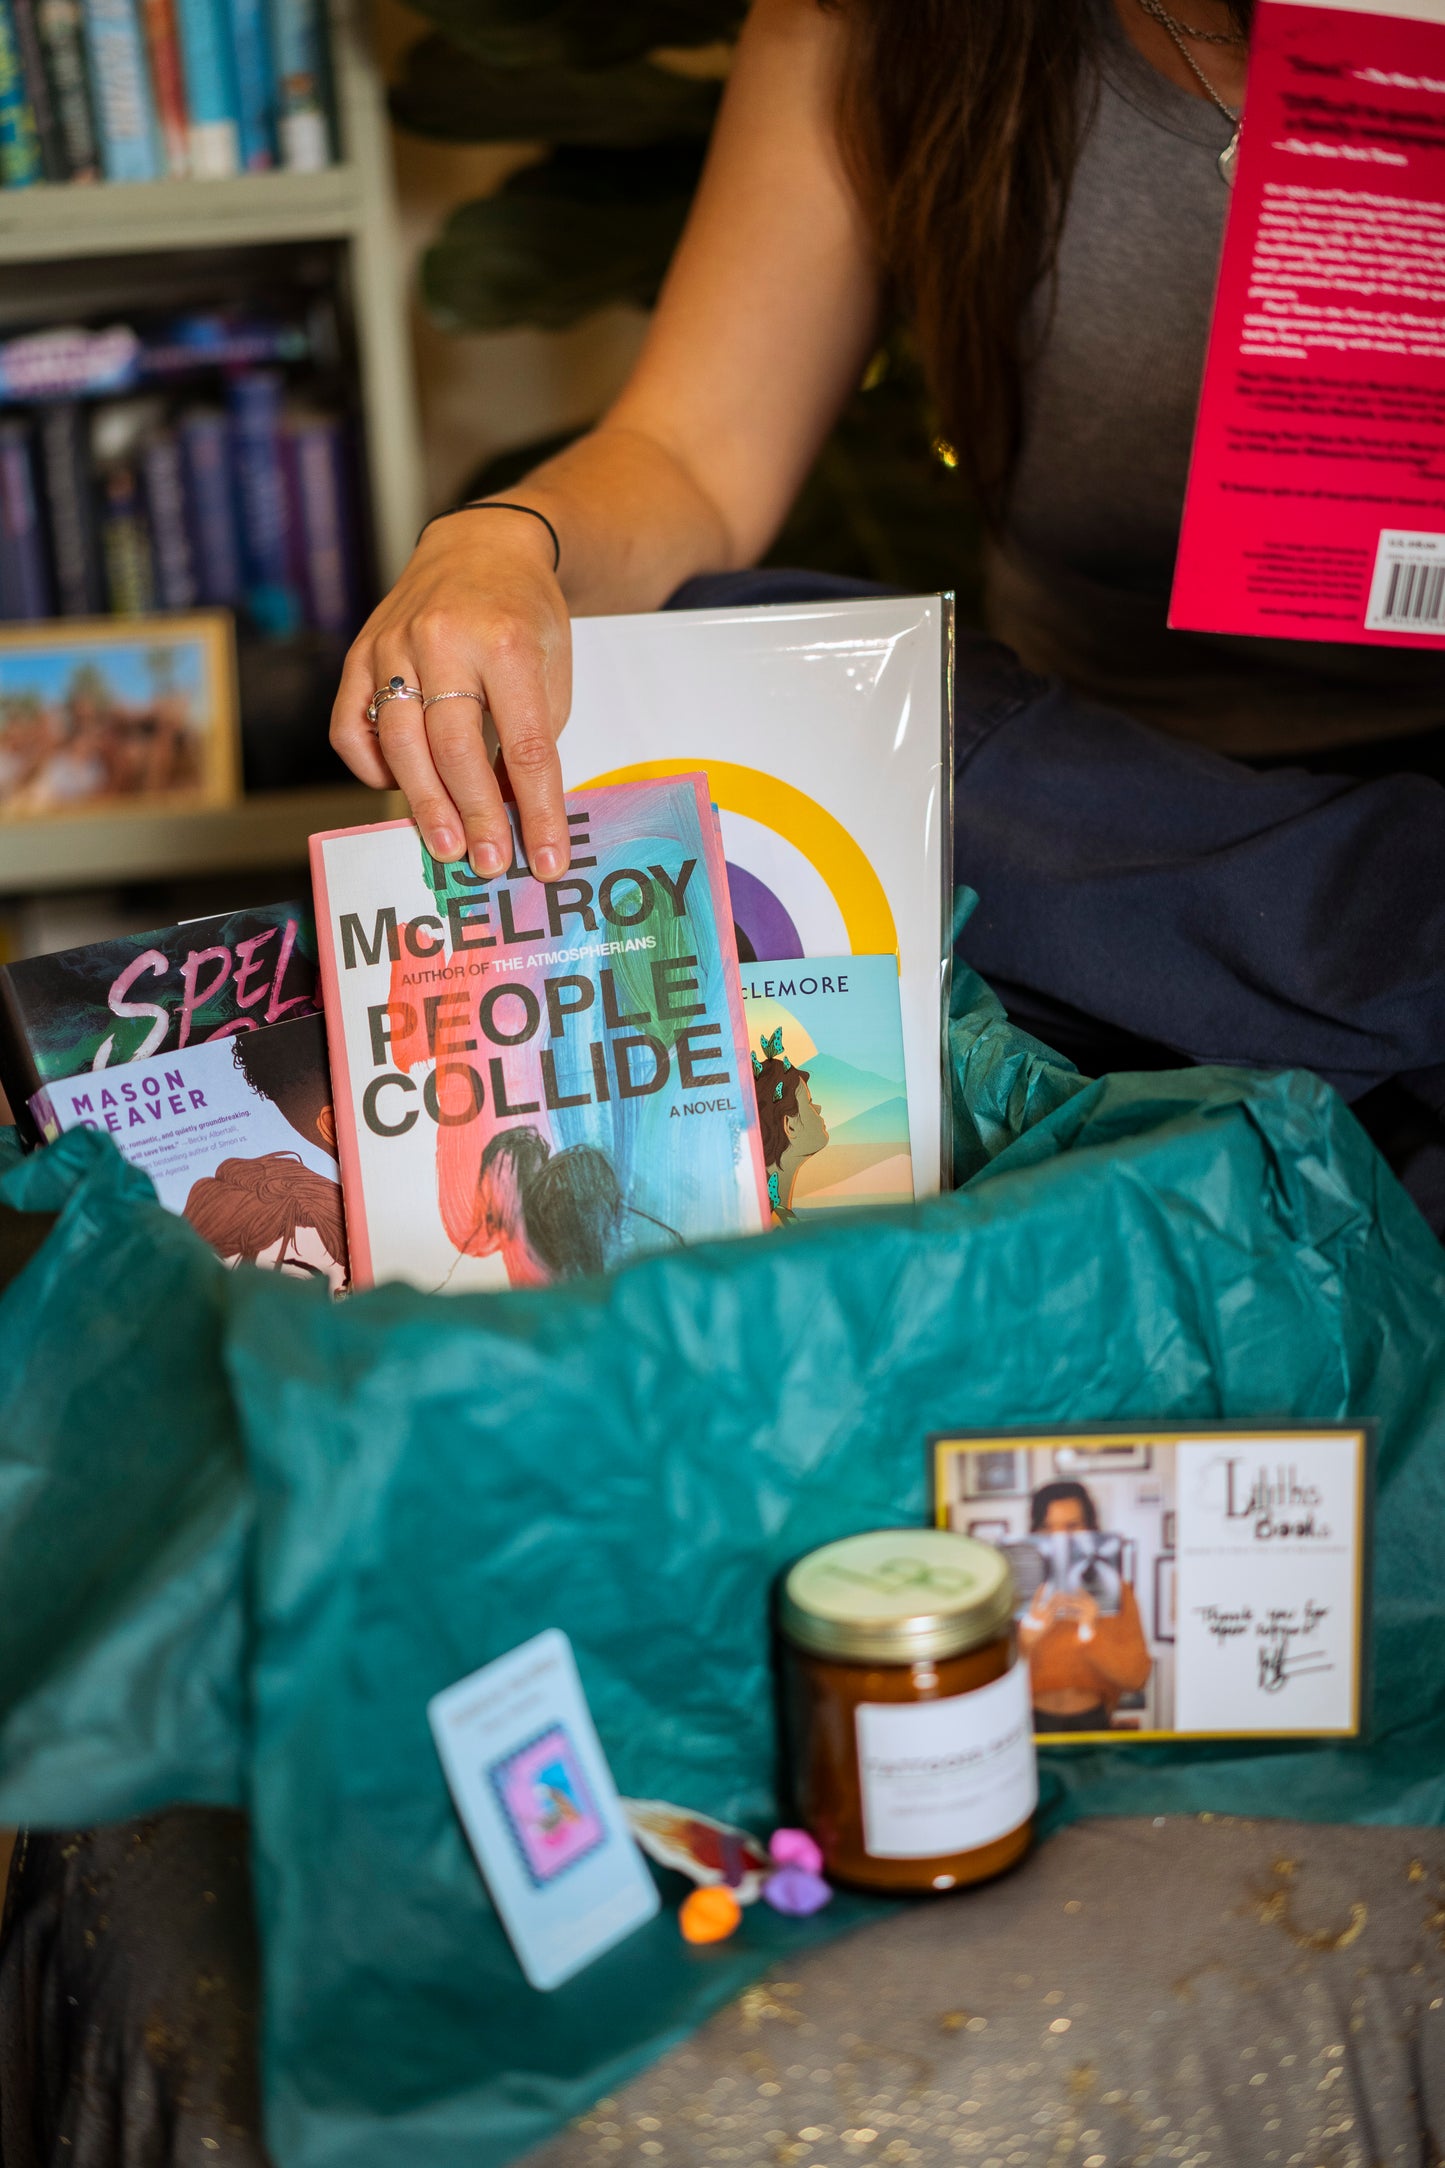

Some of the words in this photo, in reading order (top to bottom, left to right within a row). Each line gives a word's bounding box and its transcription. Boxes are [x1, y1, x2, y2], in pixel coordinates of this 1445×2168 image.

[339, 858, 698, 970] McELROY
[401, 965, 466, 987] AUTHOR
[469, 961, 490, 977] OF
[492, 957, 523, 973] THE
[526, 935, 657, 969] ATMOSPHERIANS
[92, 918, 325, 1072] SPEL
[366, 955, 707, 1067] PEOPLE
[742, 975, 849, 1000] cLEMORE
[71, 1069, 185, 1116] MASON
[362, 1023, 731, 1138] COLLIDE
[162, 1130, 174, 1140] and
[174, 1124, 198, 1137] quietly
[669, 1106, 681, 1119] A
[682, 1098, 737, 1116] NOVEL
